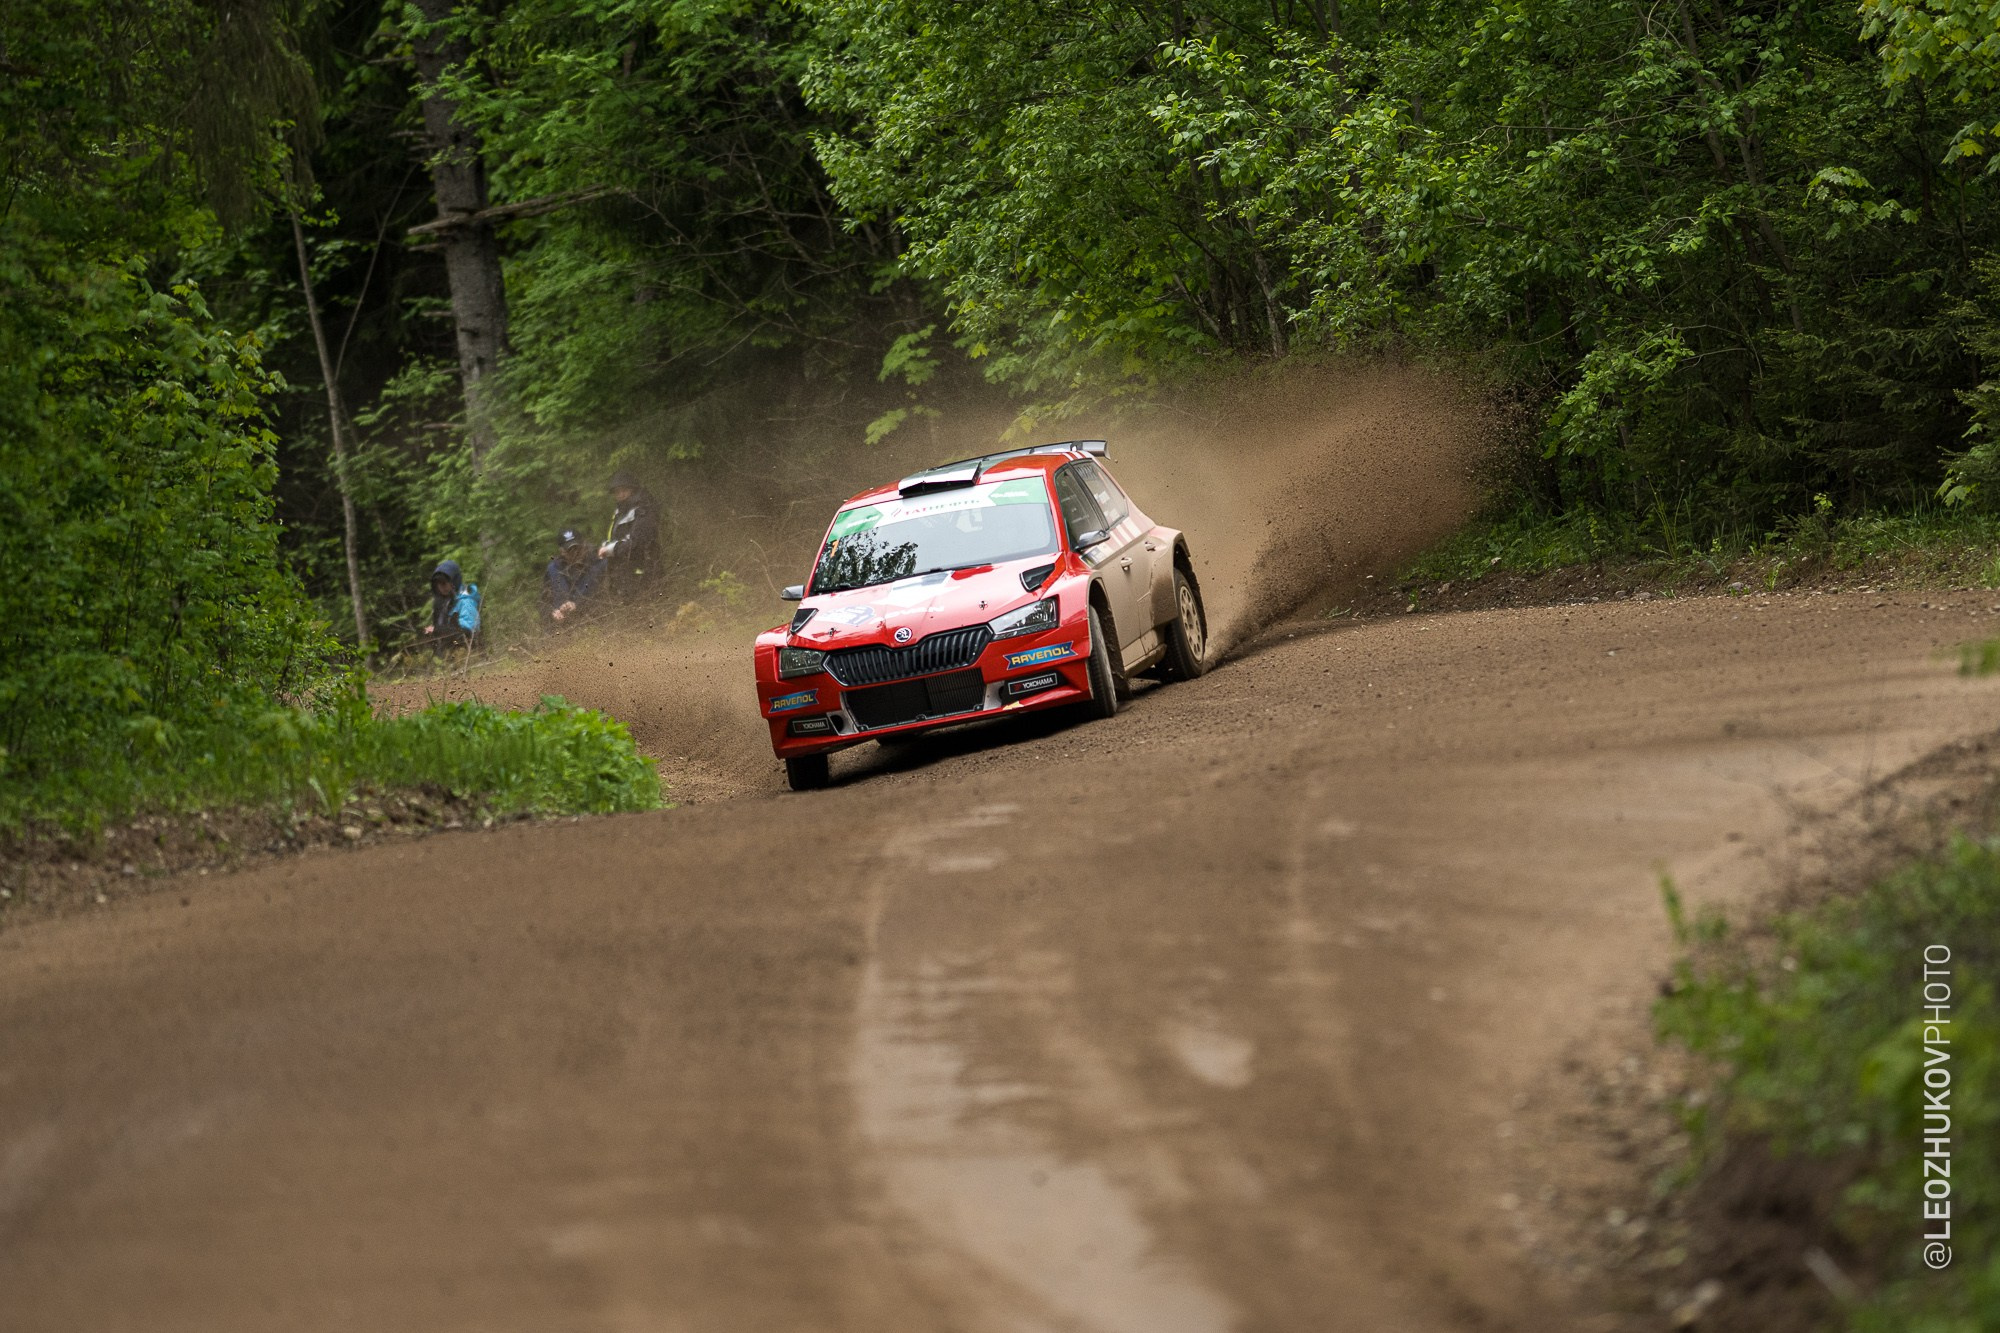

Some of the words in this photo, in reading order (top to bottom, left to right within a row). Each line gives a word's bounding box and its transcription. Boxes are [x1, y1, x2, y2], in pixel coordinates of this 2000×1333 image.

[1011, 647, 1070, 665] RAVENOL
[1022, 677, 1054, 689] YOKOHAMA
[773, 694, 814, 709] RAVENOL
[802, 721, 826, 730] YOKOHAMA
